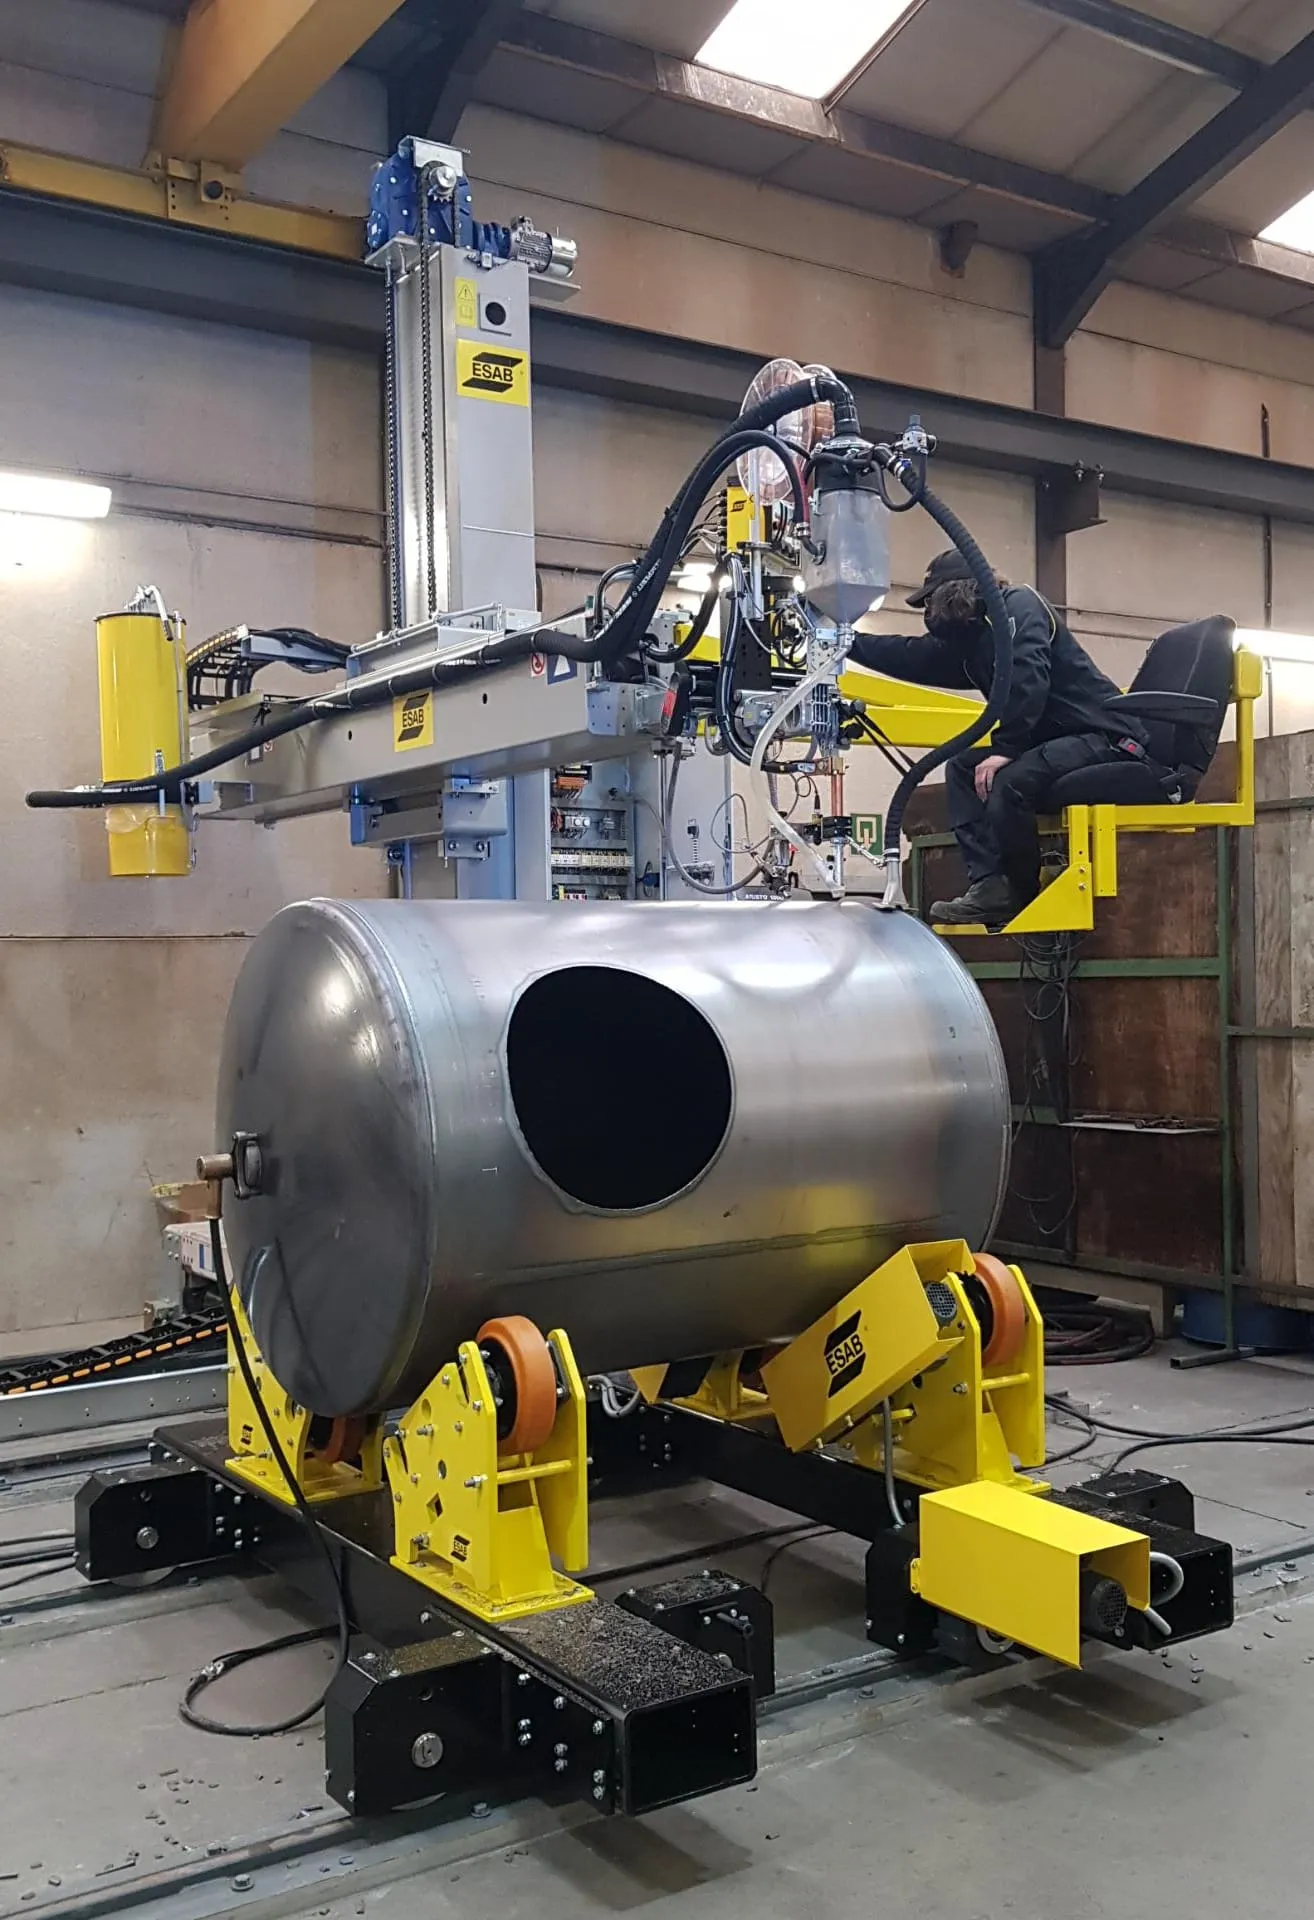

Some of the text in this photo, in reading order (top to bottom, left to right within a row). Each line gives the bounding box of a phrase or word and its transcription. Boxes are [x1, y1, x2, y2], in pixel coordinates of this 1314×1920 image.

[472, 362, 513, 382] ESAB
[402, 708, 425, 728] ESAB
[826, 1334, 863, 1375] ESAB
